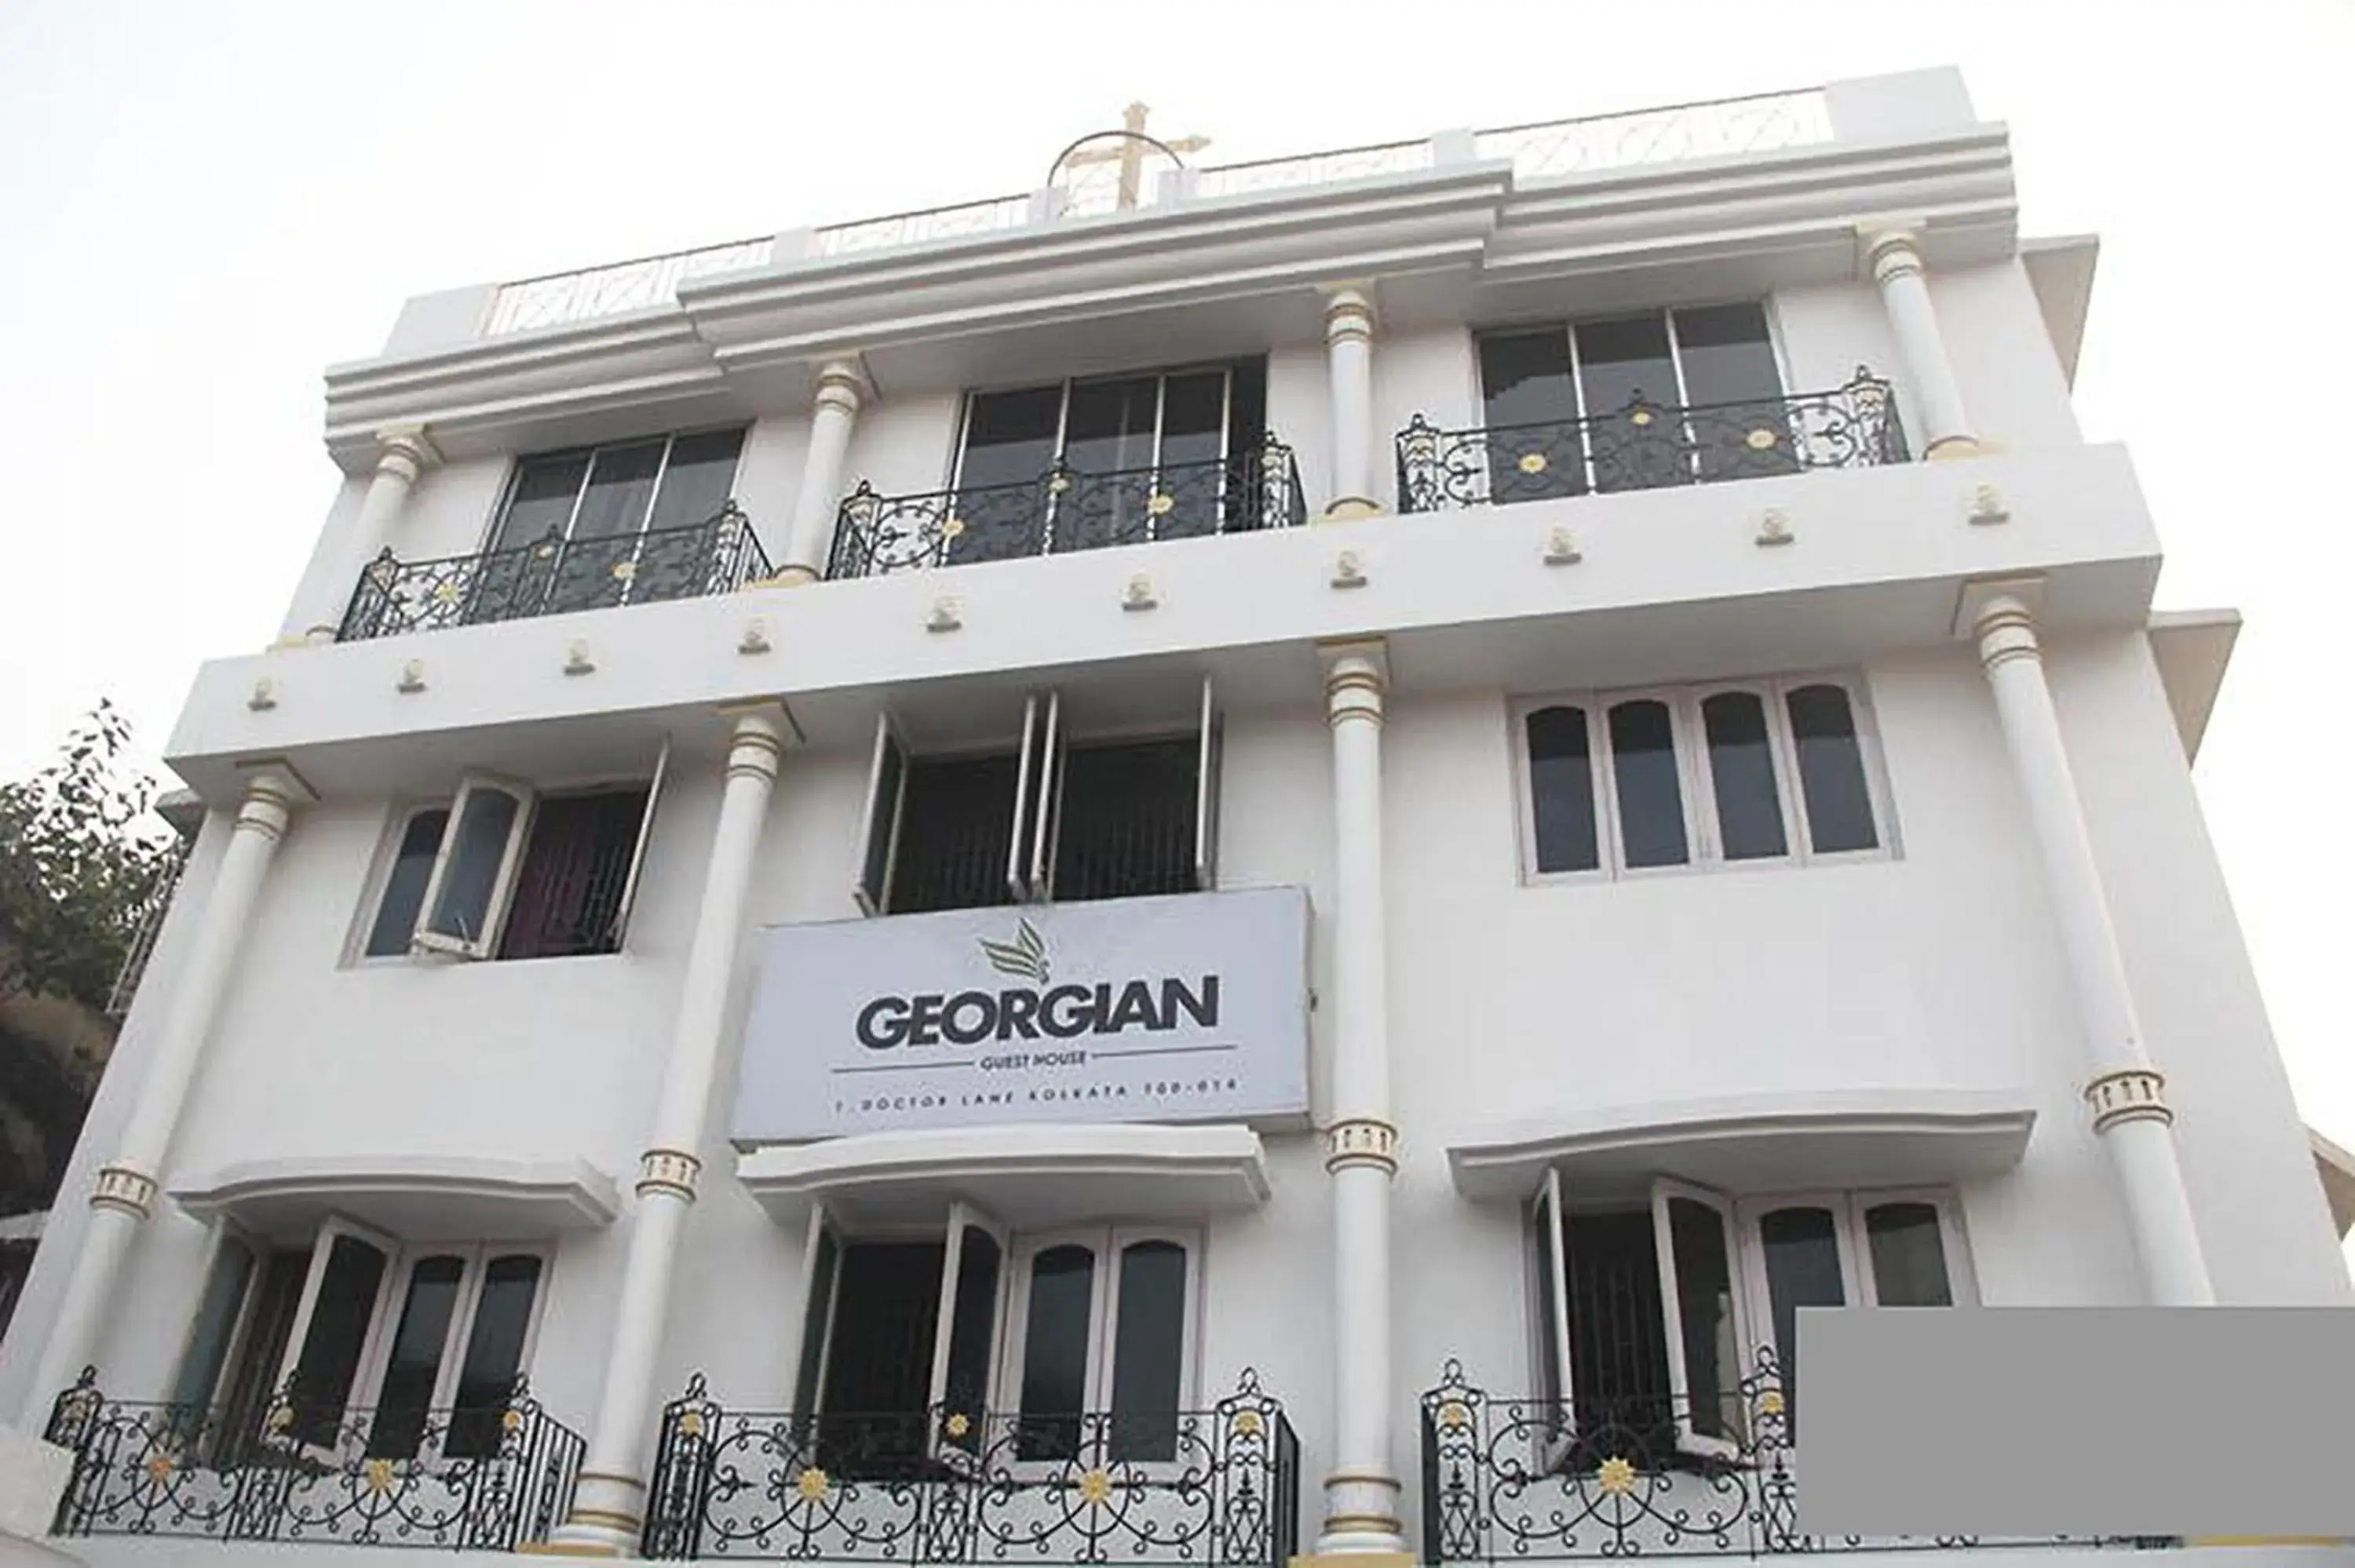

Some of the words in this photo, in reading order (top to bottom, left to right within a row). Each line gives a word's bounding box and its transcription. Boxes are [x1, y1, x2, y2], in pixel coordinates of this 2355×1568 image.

[856, 975, 1219, 1049] GEORGIAN
[980, 1055, 1030, 1071] GUEST
[1032, 1050, 1086, 1068] HOUSE
[861, 1095, 946, 1112] DOCTOR
